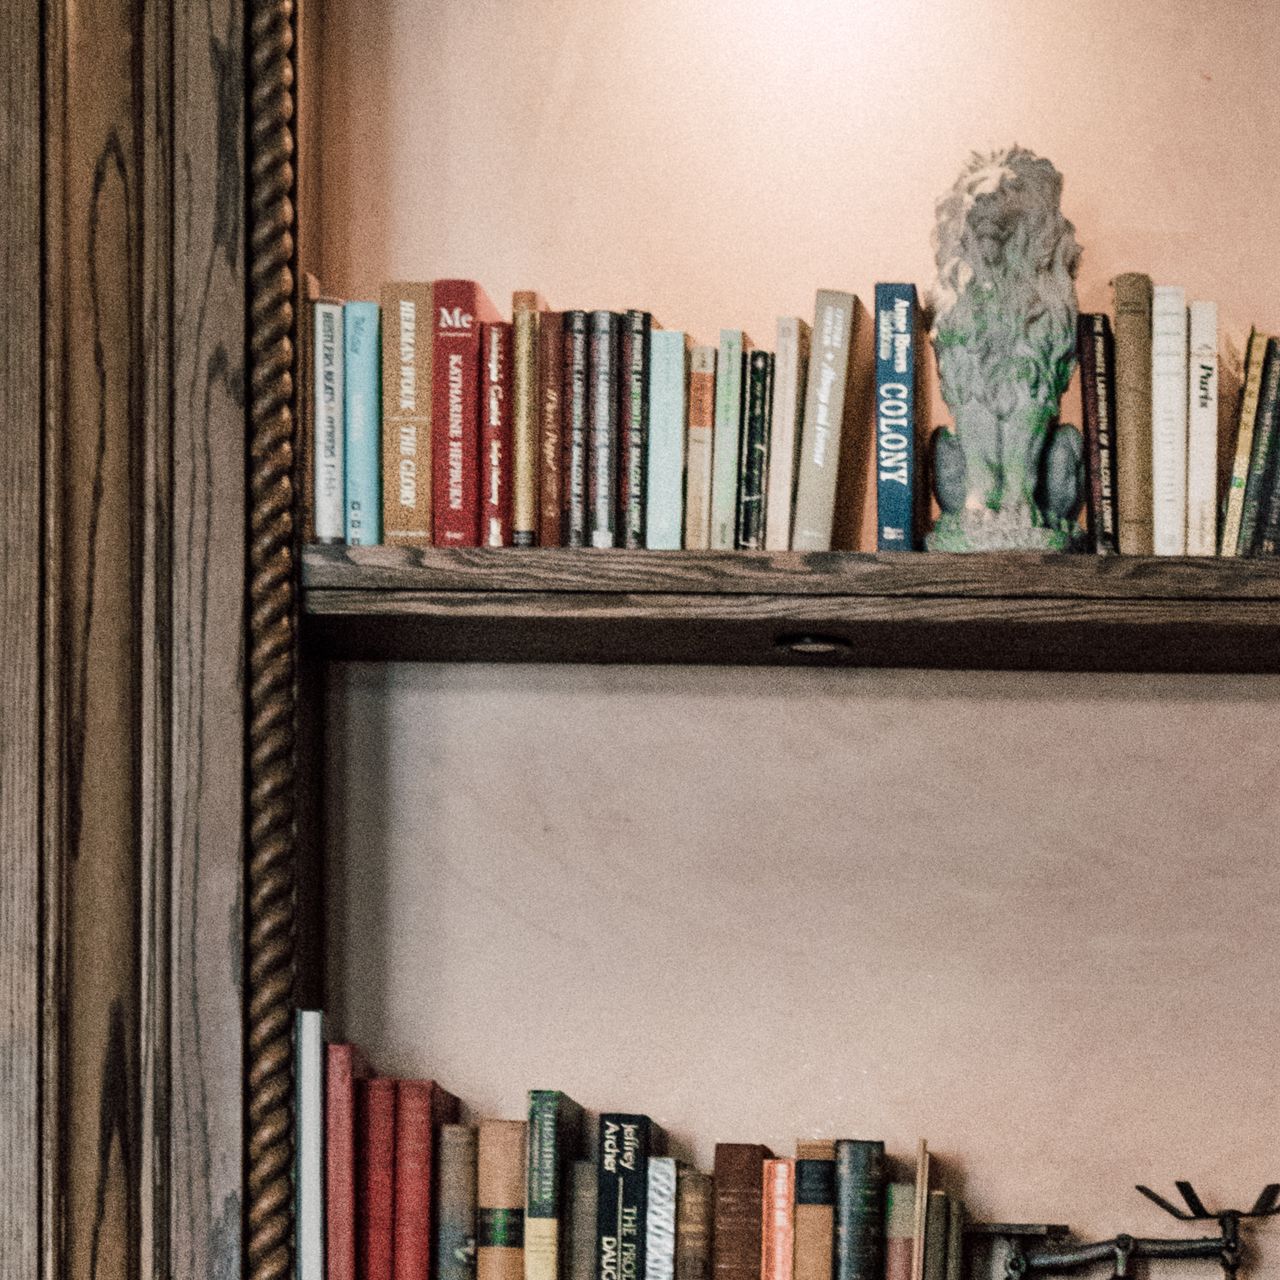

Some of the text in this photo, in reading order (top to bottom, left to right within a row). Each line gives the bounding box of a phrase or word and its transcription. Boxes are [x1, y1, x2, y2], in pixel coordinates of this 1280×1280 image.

[399, 300, 416, 411] HERMAN WOUK
[399, 424, 416, 508] THE GLORY
[449, 354, 462, 510] KATHARINE HEPBURN
[880, 382, 908, 486] COLONY
[603, 1121, 619, 1174] Archer
[618, 1123, 639, 1171] Jeffrey
[620, 1206, 638, 1236] THE
